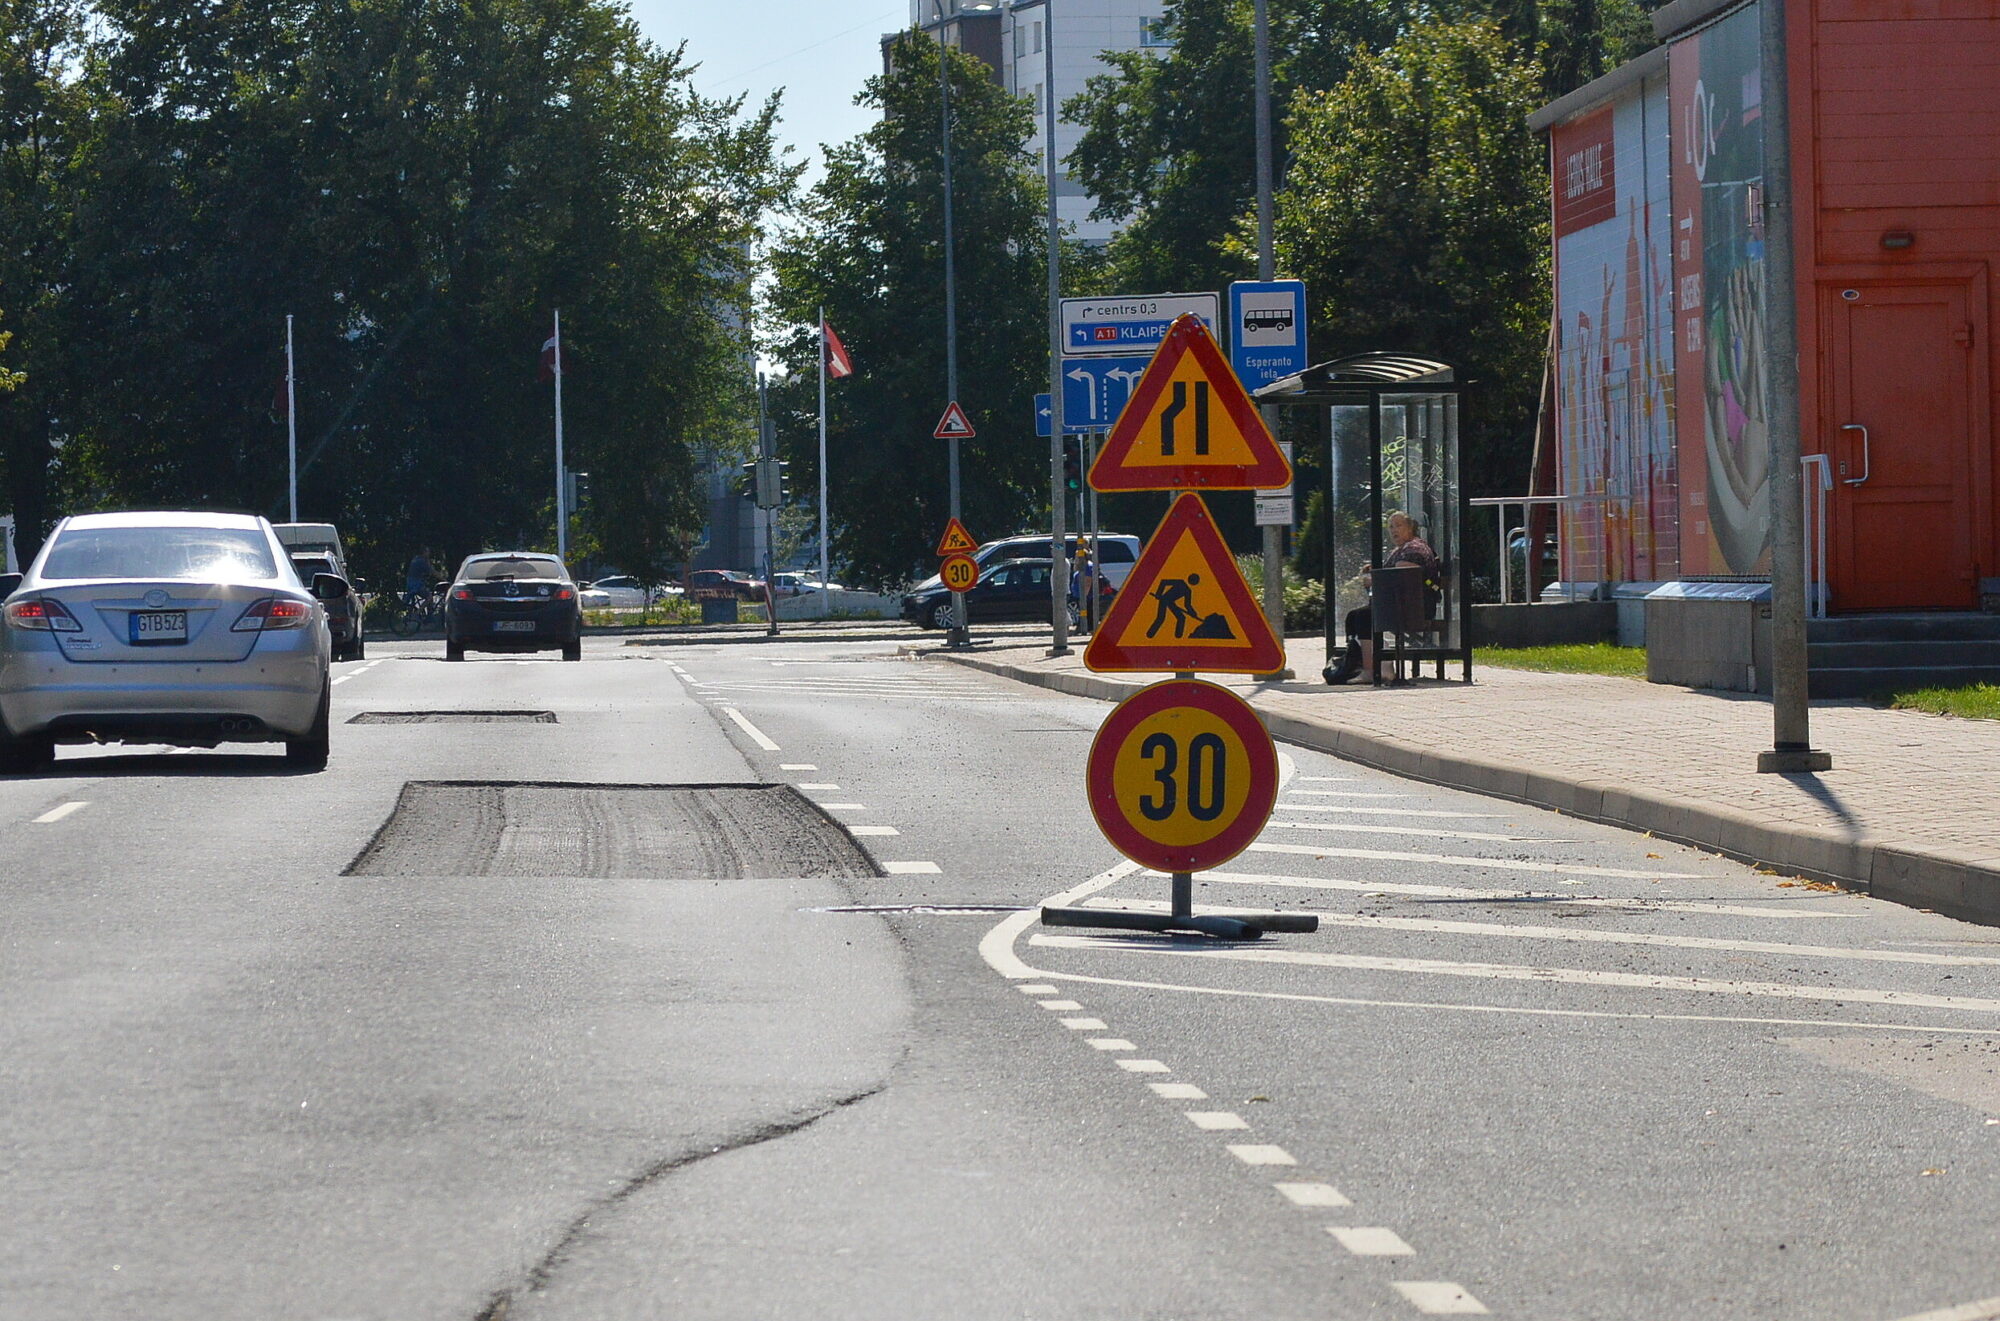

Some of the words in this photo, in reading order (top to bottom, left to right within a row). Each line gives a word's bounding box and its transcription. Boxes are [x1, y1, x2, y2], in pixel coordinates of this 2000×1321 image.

[1097, 305, 1137, 316] centrs
[1140, 303, 1157, 315] 0,3
[1121, 325, 1169, 339] KLAIPĒ
[1245, 356, 1292, 370] Esperanto
[1260, 368, 1278, 379] iela
[950, 564, 969, 583] 30
[1139, 732, 1226, 821] 30
